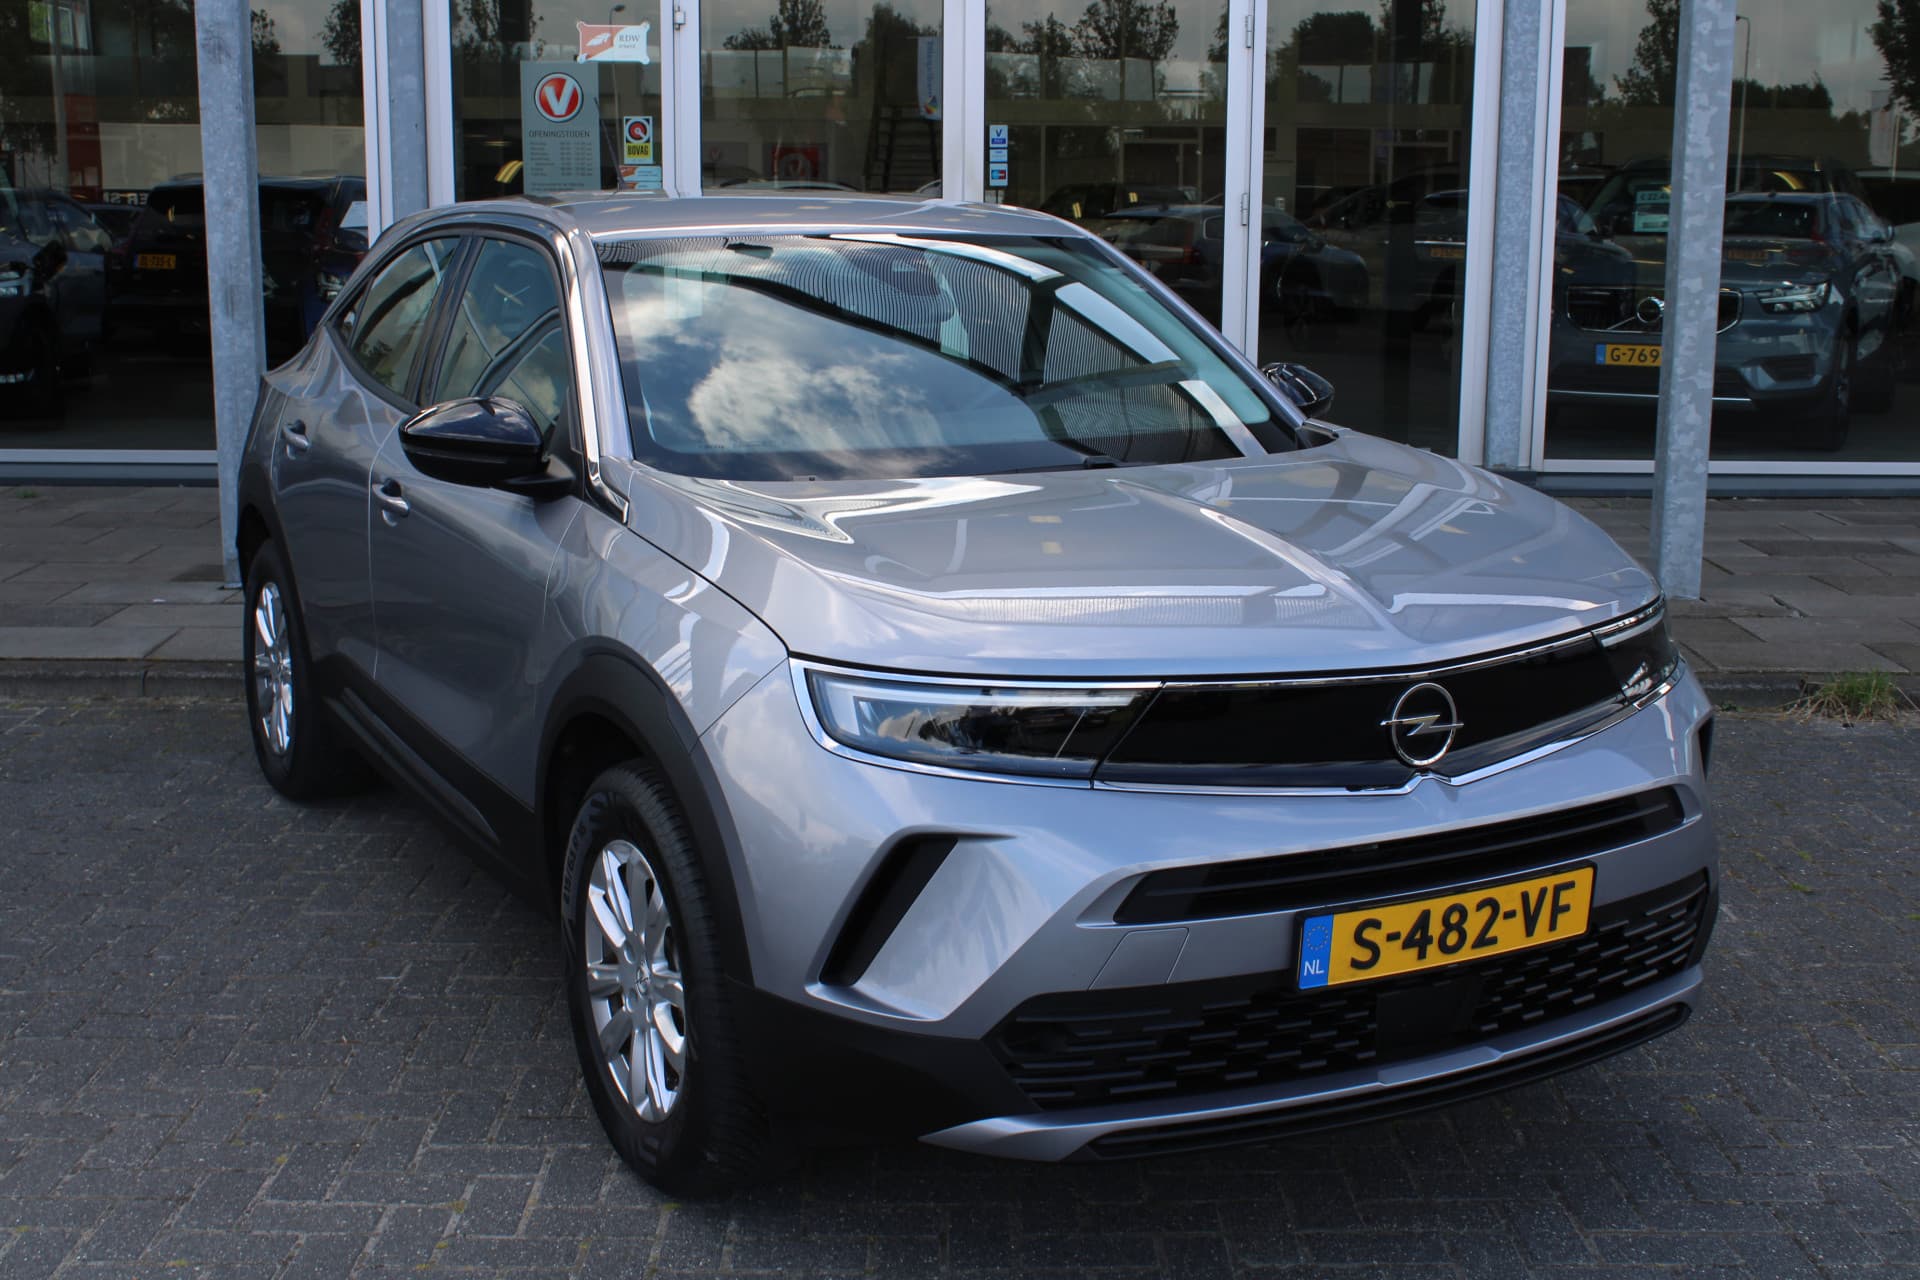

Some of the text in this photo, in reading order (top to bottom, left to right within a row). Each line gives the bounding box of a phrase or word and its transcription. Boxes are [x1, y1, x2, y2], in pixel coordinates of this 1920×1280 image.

[627, 144, 649, 155] BOVAG
[1610, 347, 1660, 364] G-769
[1350, 880, 1576, 971] S-482-VF
[1303, 959, 1325, 976] NL
